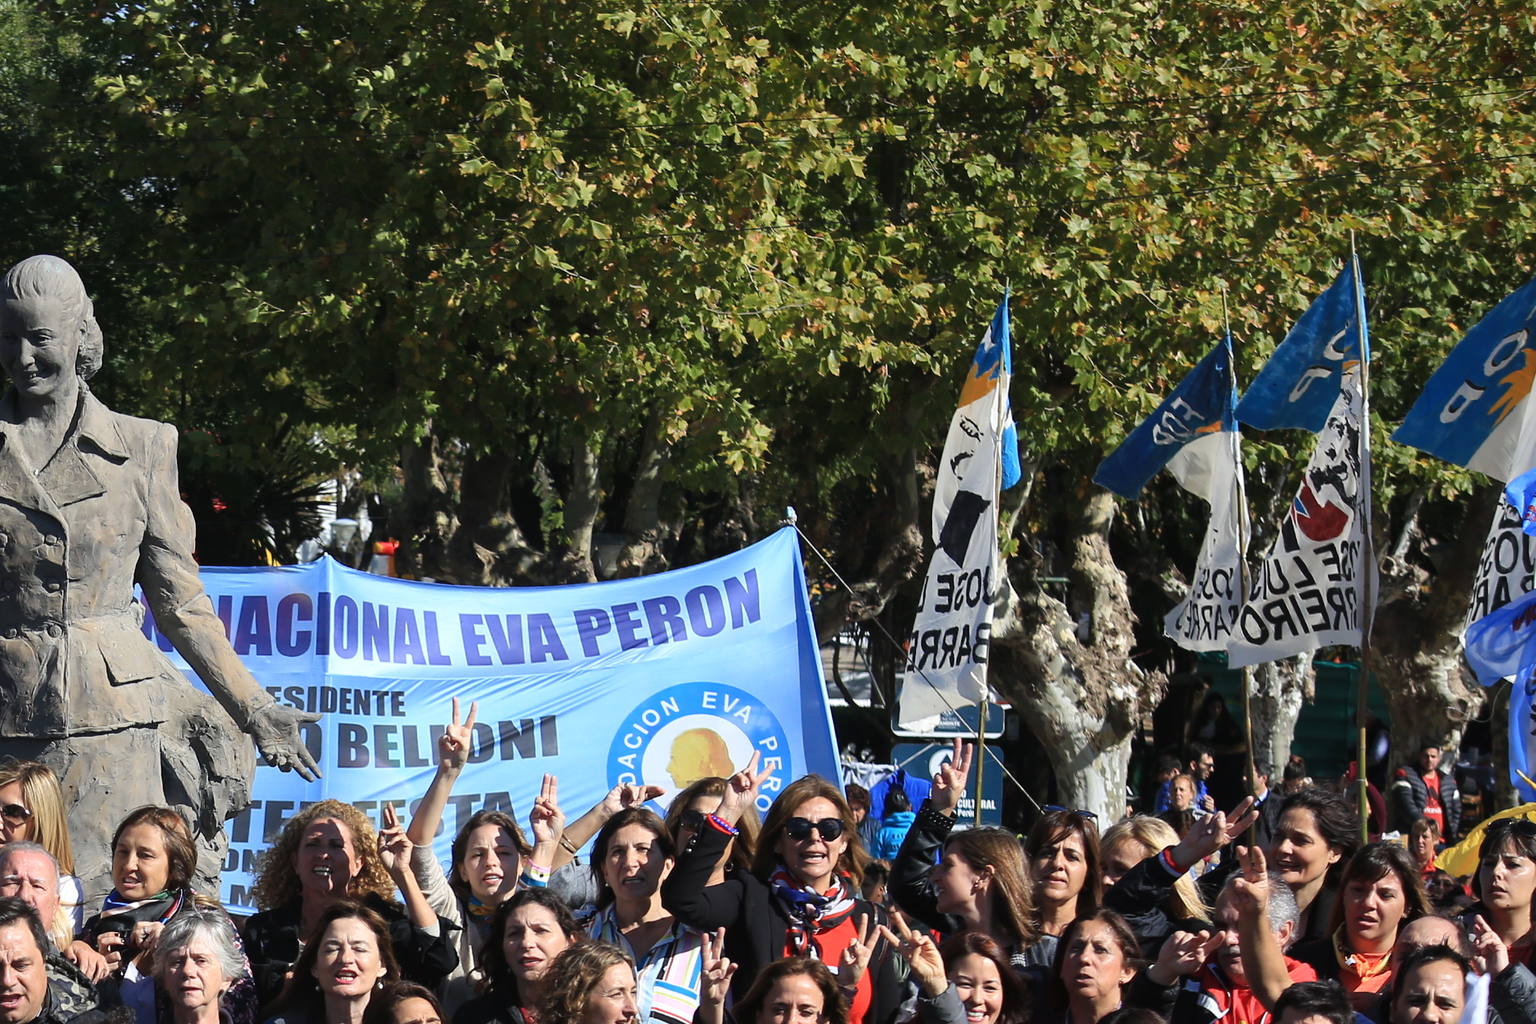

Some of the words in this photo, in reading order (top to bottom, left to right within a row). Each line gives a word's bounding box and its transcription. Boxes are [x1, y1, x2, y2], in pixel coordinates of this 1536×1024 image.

[458, 612, 569, 667] EVA
[573, 567, 762, 659] PERON
[266, 685, 406, 717] ESIDENTE
[617, 696, 680, 787] DACION
[701, 690, 753, 724] EVA
[754, 735, 783, 812] PERO
[957, 799, 997, 810] CULTRAL
